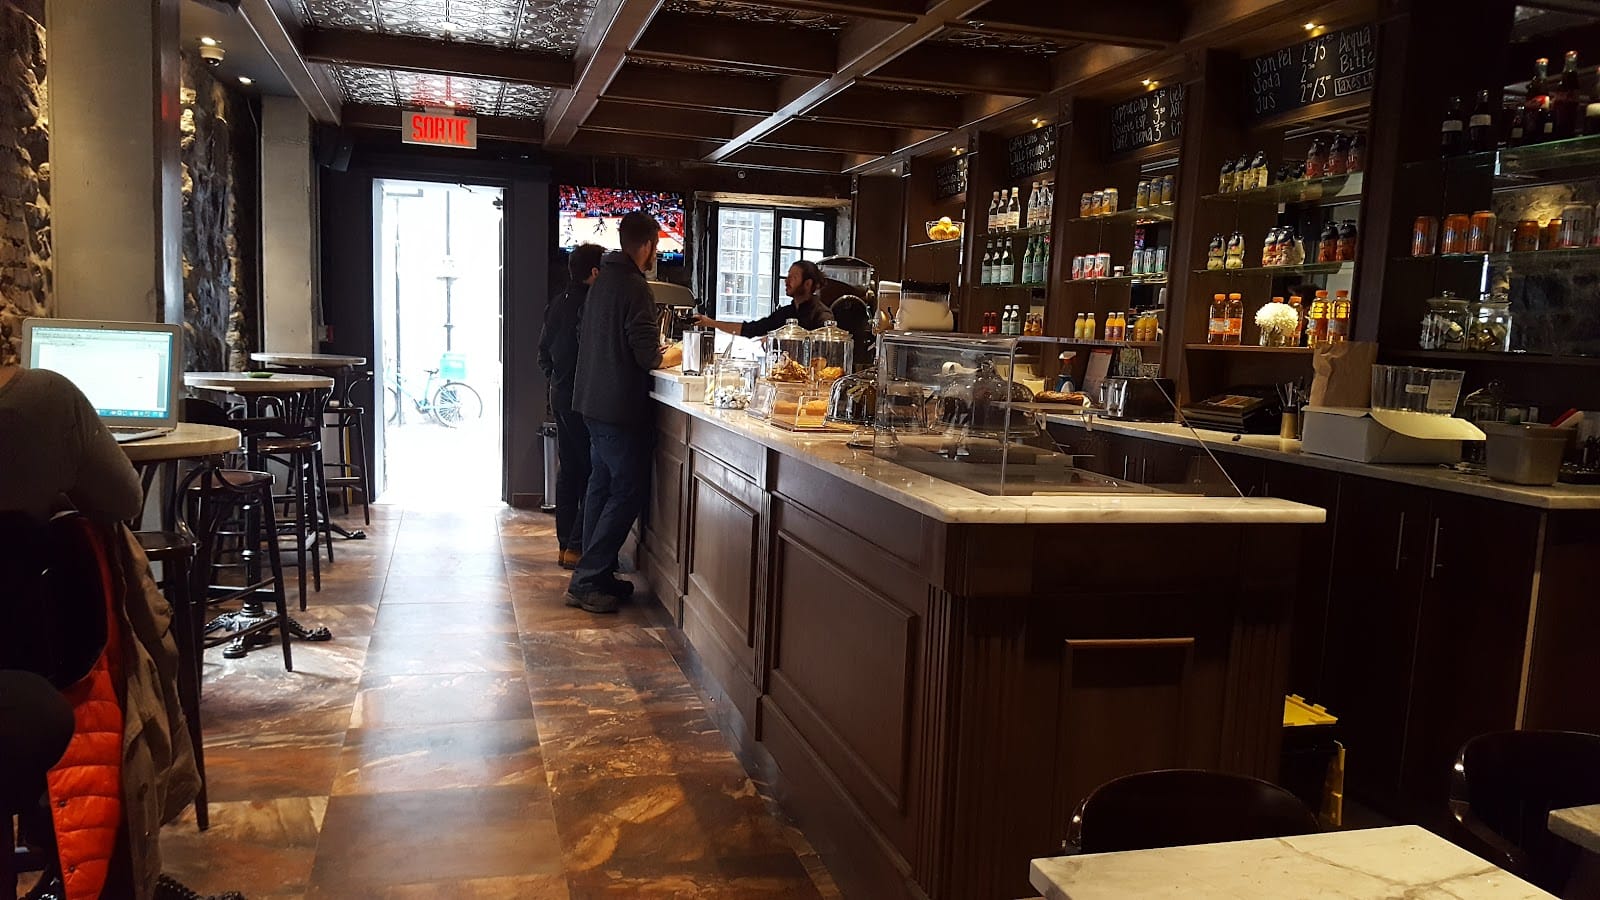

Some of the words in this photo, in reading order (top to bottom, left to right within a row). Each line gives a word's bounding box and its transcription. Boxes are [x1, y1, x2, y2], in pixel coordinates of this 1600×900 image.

[1339, 26, 1371, 57] Acqua
[1253, 57, 1276, 78] San
[1278, 47, 1292, 69] Pel
[1253, 72, 1281, 95] Soda
[412, 113, 470, 145] SORTIE
